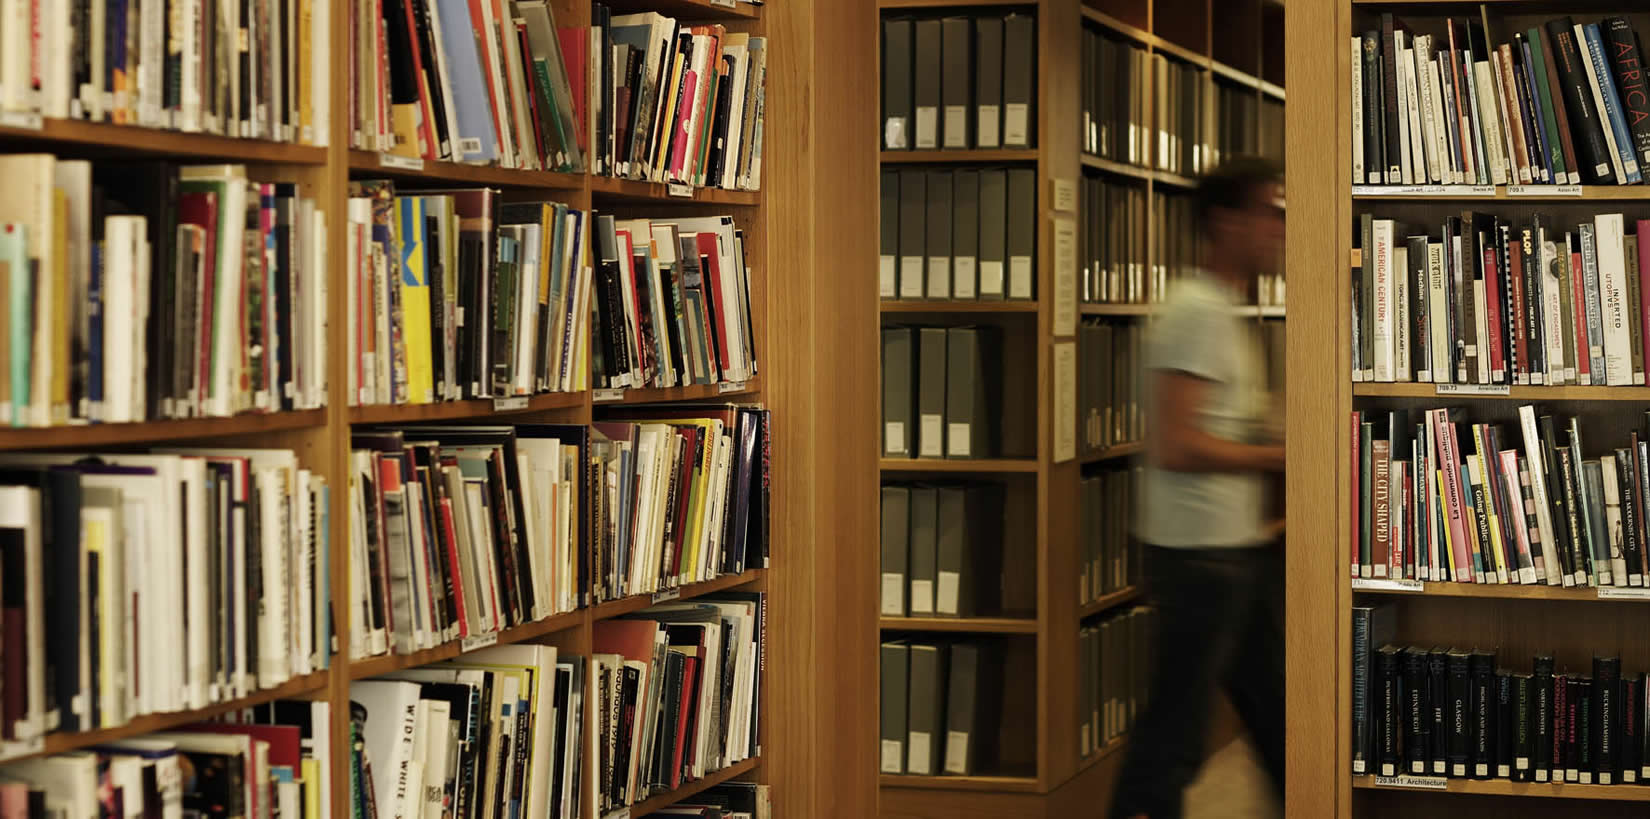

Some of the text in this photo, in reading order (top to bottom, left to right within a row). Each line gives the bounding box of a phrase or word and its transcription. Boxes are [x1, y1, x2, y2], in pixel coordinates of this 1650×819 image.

[1616, 42, 1649, 126] AFRICA
[1523, 230, 1531, 255] PLOP
[1377, 241, 1386, 324] AMERICAN CENTURY
[1377, 458, 1388, 478] THE
[1447, 462, 1458, 507] commande
[1377, 480, 1388, 501] CITY
[1475, 490, 1484, 513] Going
[1377, 503, 1388, 542] SHAPED
[1453, 509, 1459, 519] La
[1626, 502, 1634, 535] MODERNIST
[613, 668, 623, 720] bauhaus
[397, 704, 415, 799] WIDE WHITE
